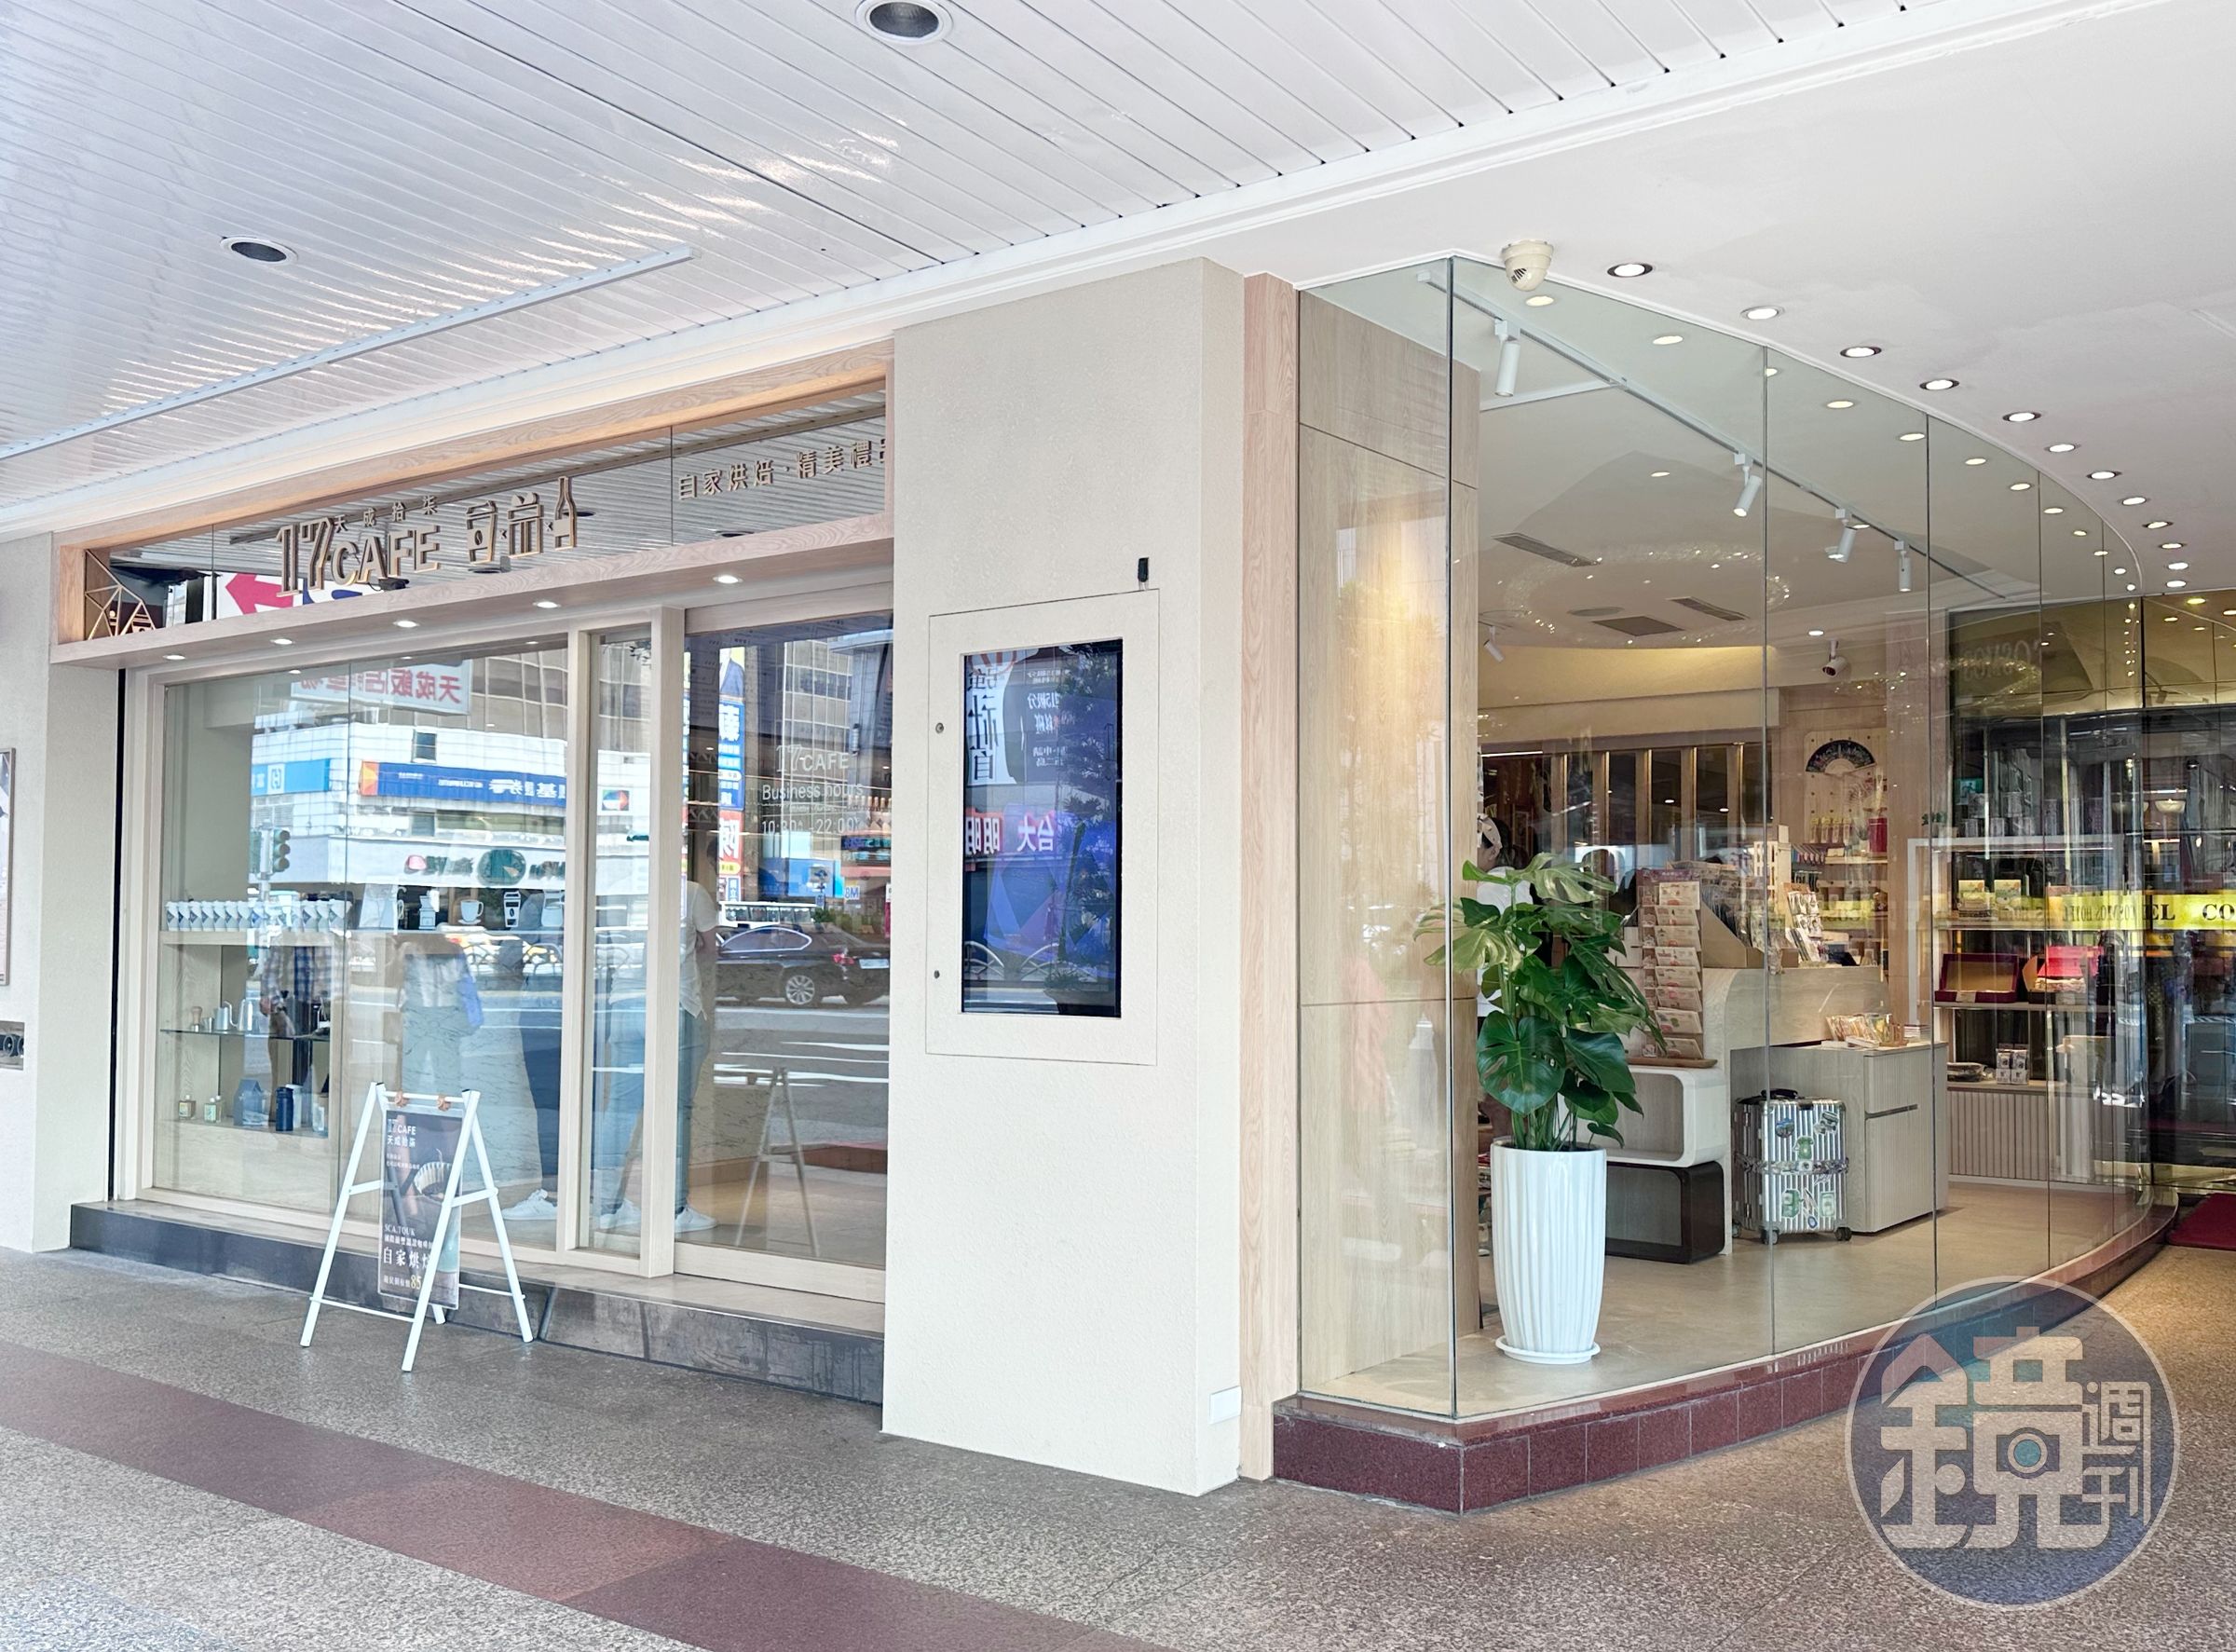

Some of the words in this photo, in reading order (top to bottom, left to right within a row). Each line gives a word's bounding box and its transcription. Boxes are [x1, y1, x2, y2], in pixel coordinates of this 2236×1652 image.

[334, 495, 439, 533] 天成拾柒
[761, 784, 821, 800] Business
